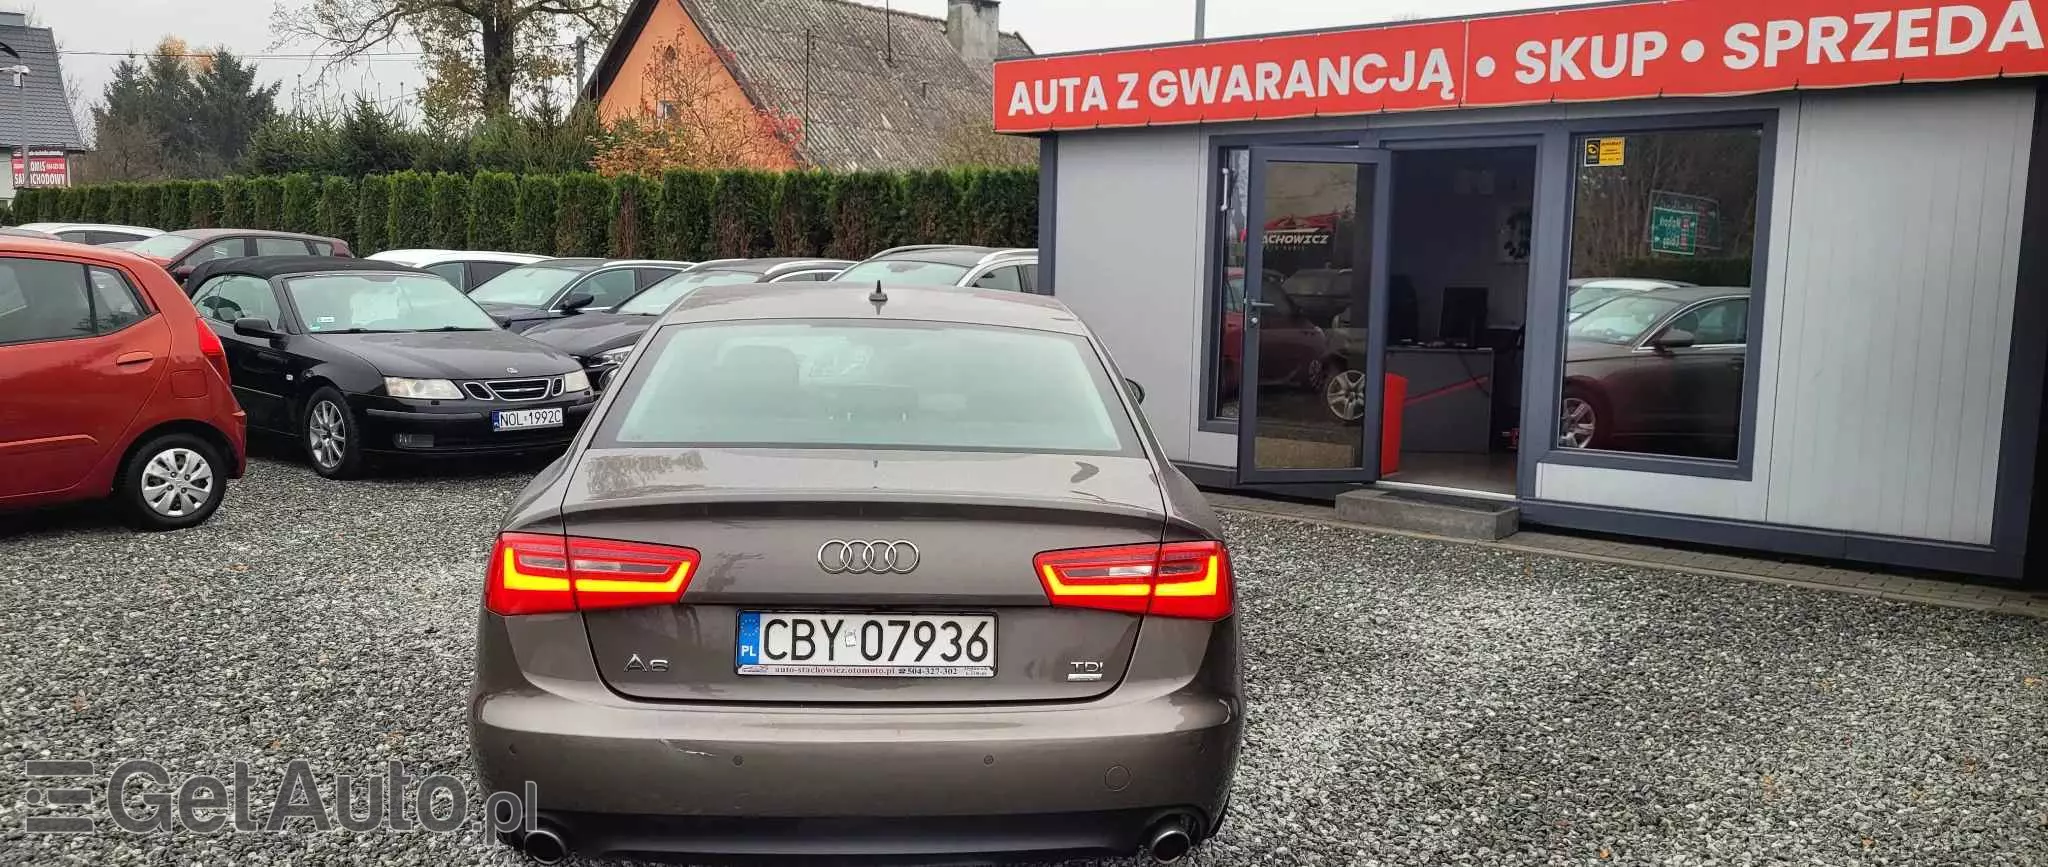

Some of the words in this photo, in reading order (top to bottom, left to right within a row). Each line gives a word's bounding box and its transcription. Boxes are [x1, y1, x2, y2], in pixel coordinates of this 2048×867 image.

[1515, 31, 1668, 85] SKUP
[1007, 76, 1107, 116] AUTA
[1116, 73, 1139, 110] Z
[1147, 47, 1455, 108] GWARANCJĄ
[1262, 235, 1329, 244] ACHOWICZ
[500, 413, 523, 426] NOL
[529, 410, 561, 424] 1992C
[763, 618, 845, 661] CBY
[860, 619, 989, 662] 07936
[741, 646, 756, 656] PL
[623, 653, 669, 672] A6
[775, 665, 895, 675] auto-stachowicz.otomoto.pl
[1070, 661, 1103, 672] TDI
